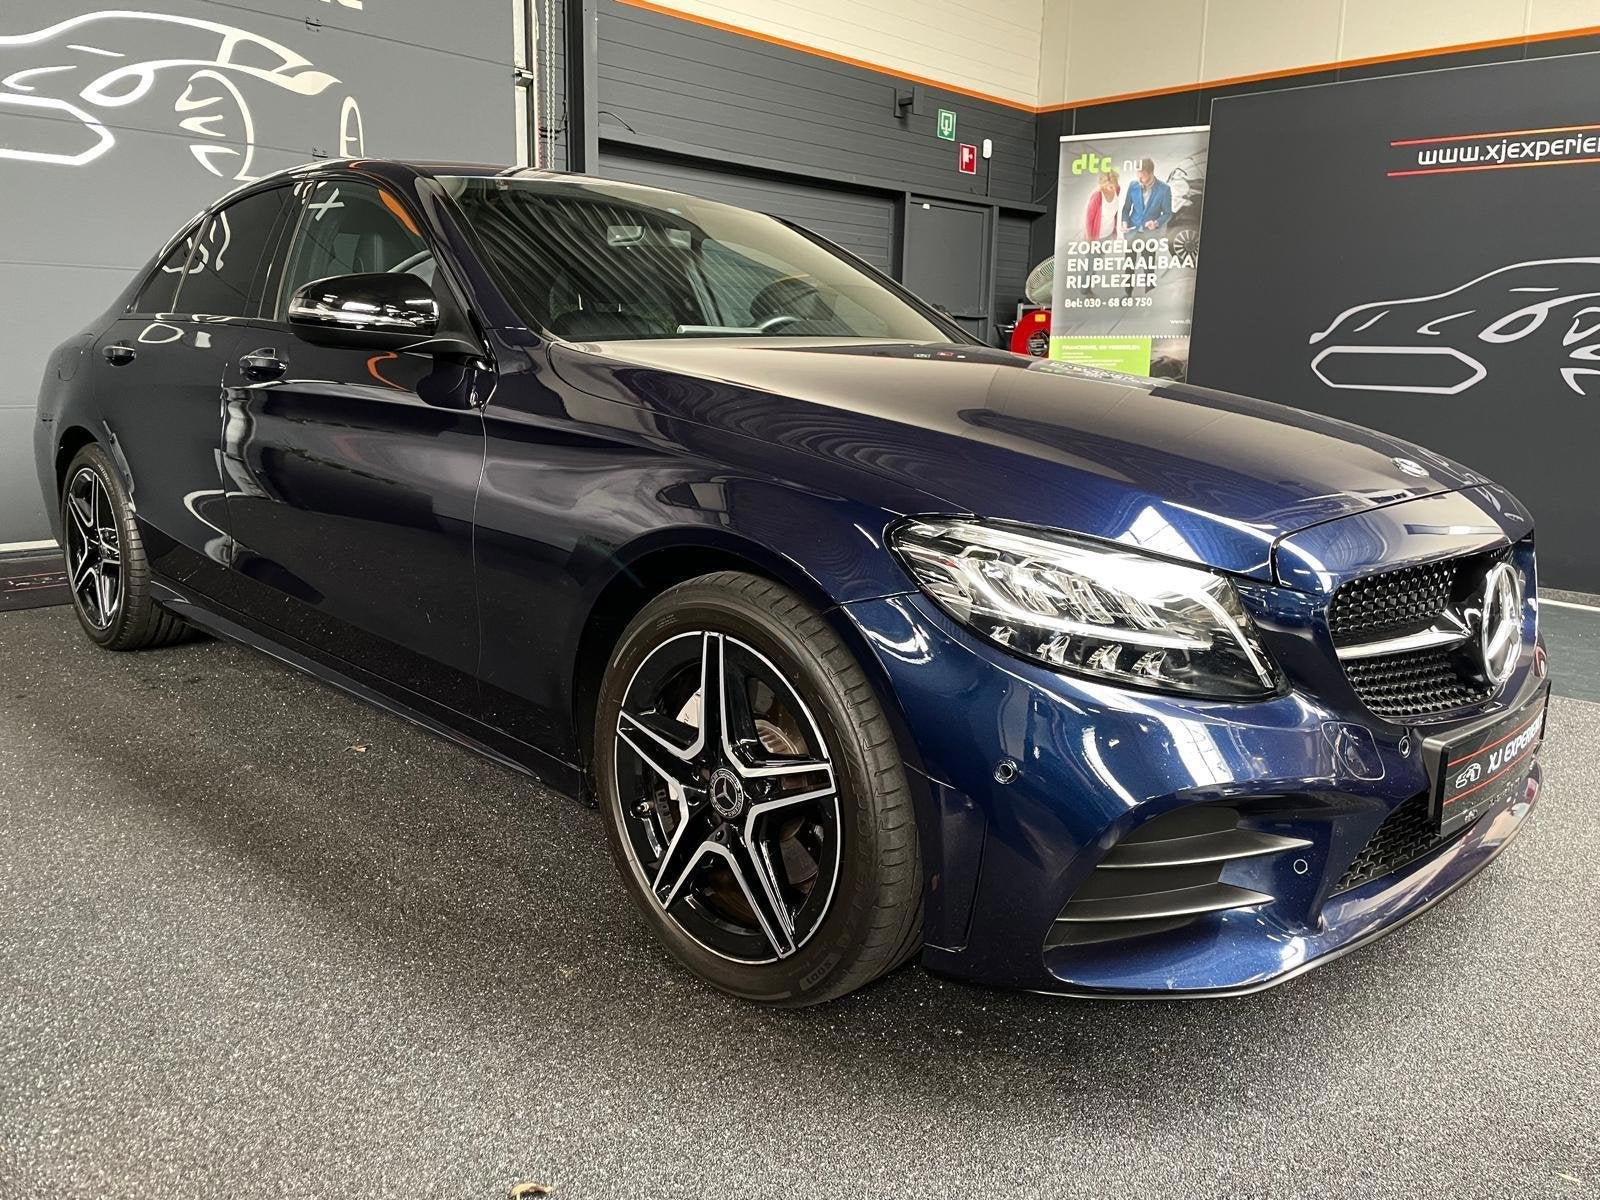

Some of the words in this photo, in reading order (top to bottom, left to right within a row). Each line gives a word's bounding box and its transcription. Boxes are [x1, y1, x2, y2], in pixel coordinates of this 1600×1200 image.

[1067, 238, 1169, 255] ZORGELOOS
[1067, 258, 1089, 272] EN
[1093, 254, 1198, 271] BETAALBAA
[1066, 273, 1158, 289] RIJPLEZIER
[1064, 299, 1082, 308] Bel:
[1084, 298, 1101, 308] 030
[1108, 298, 1120, 307] 68
[1121, 297, 1133, 307] 68
[1135, 297, 1153, 307] 750
[1487, 748, 1503, 774] XJ
